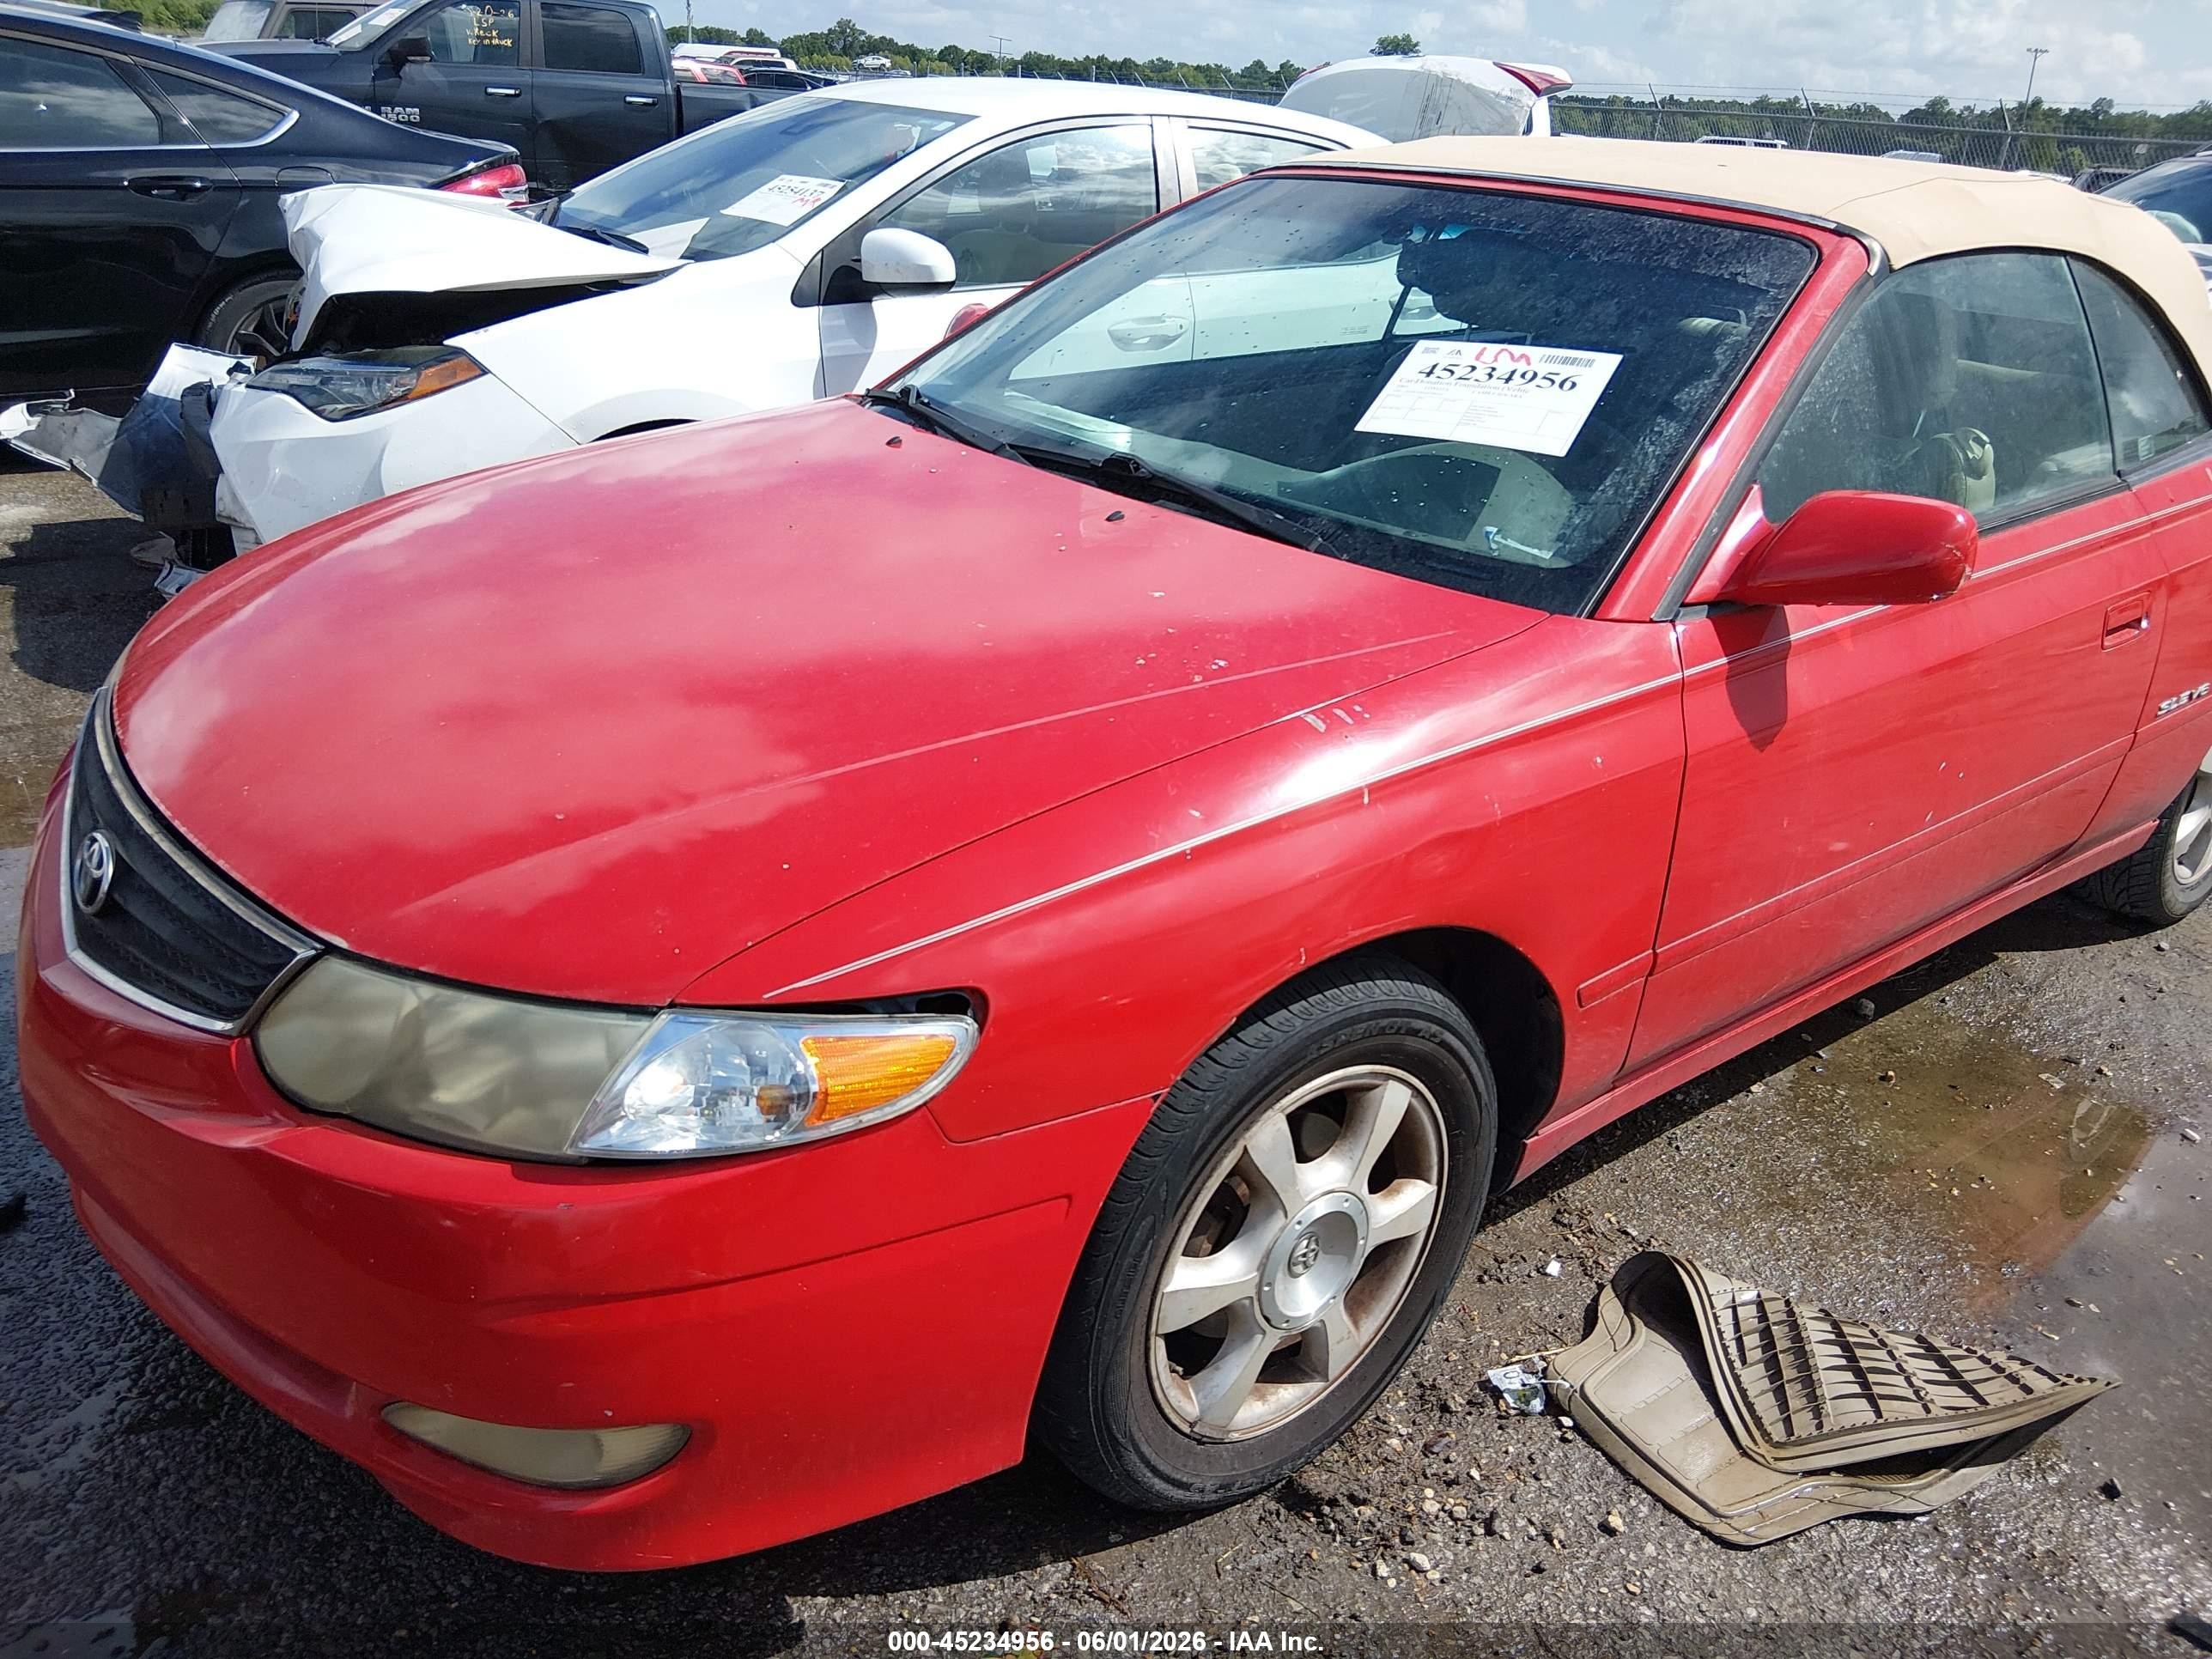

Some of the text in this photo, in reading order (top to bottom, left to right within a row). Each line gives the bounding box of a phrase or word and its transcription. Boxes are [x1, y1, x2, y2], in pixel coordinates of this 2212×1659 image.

[473, 17, 495, 27] LSP
[380, 106, 420, 115] RAM
[380, 113, 421, 122] 1500
[1418, 362, 1584, 392] 45234956
